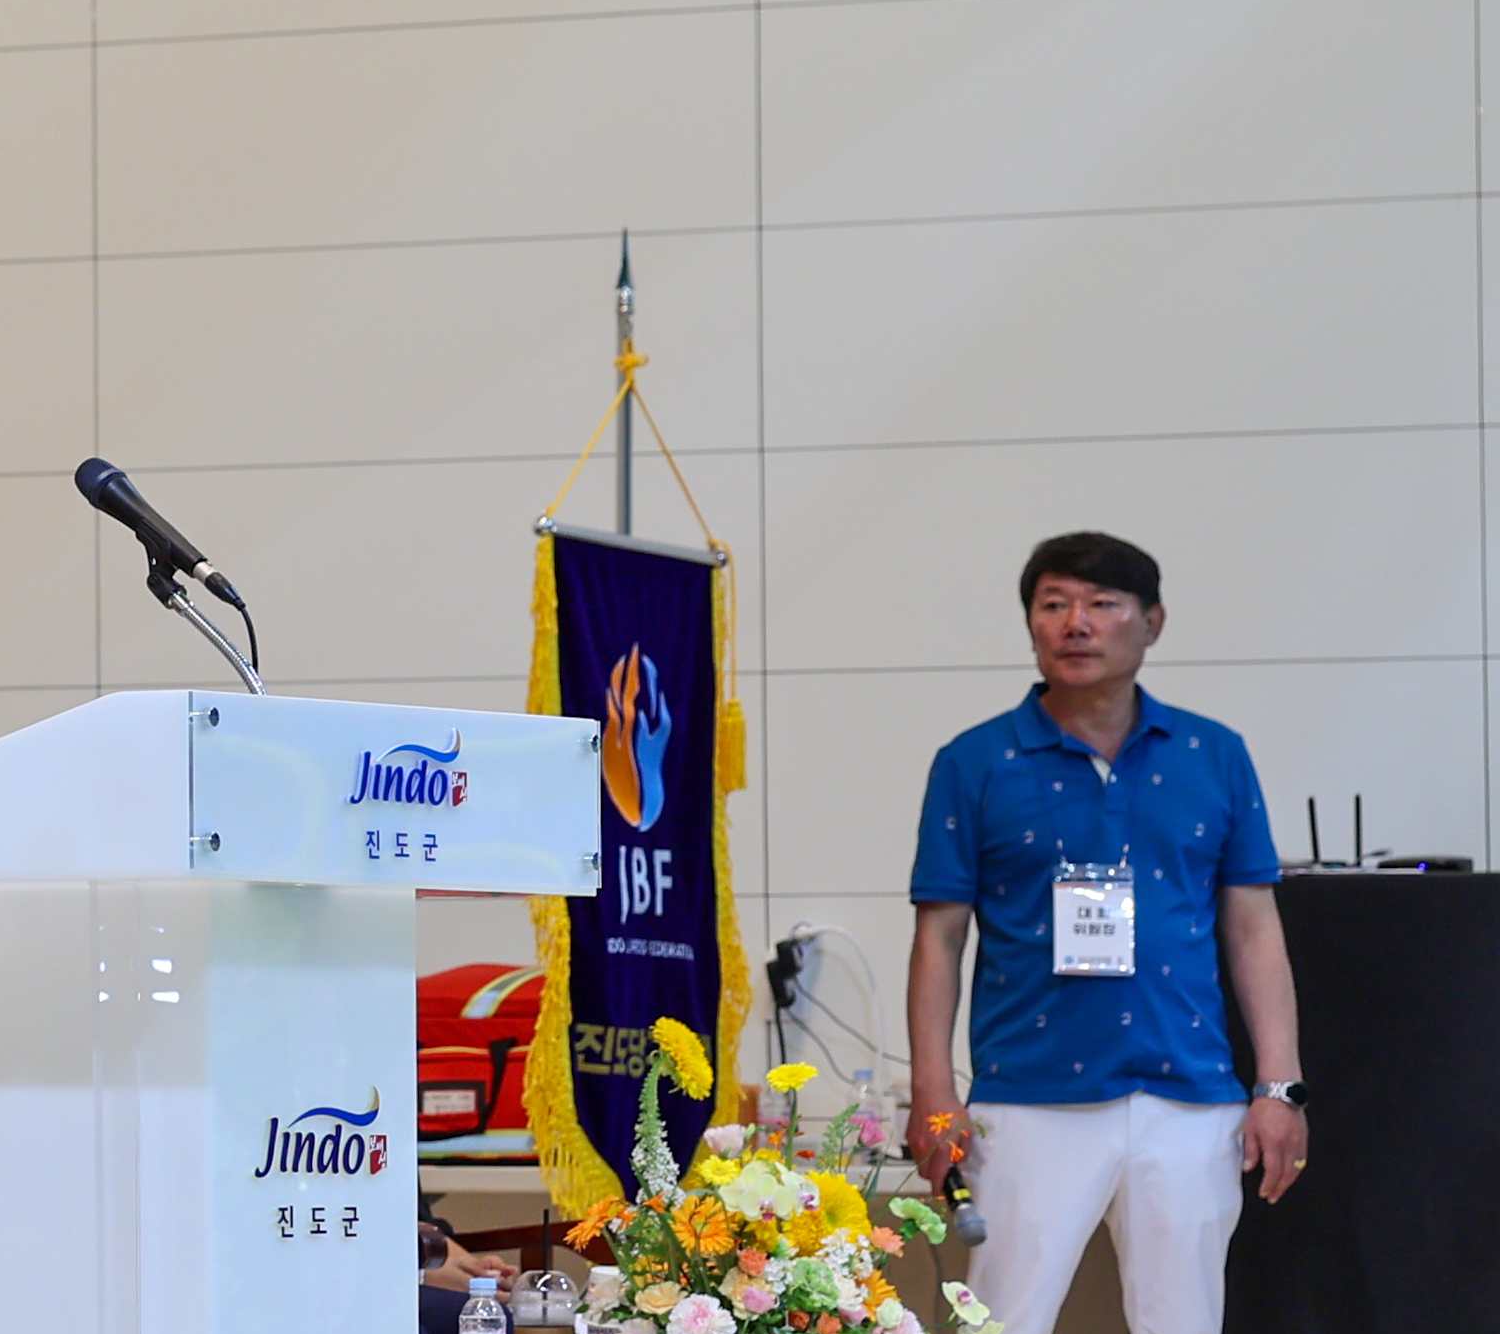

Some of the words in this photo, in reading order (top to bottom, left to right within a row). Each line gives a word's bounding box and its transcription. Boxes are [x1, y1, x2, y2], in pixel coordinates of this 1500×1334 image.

[346, 750, 449, 806] Jindo
[366, 830, 438, 862] 진도군
[254, 1117, 366, 1178] Jindo
[277, 1205, 359, 1238] 진도군
